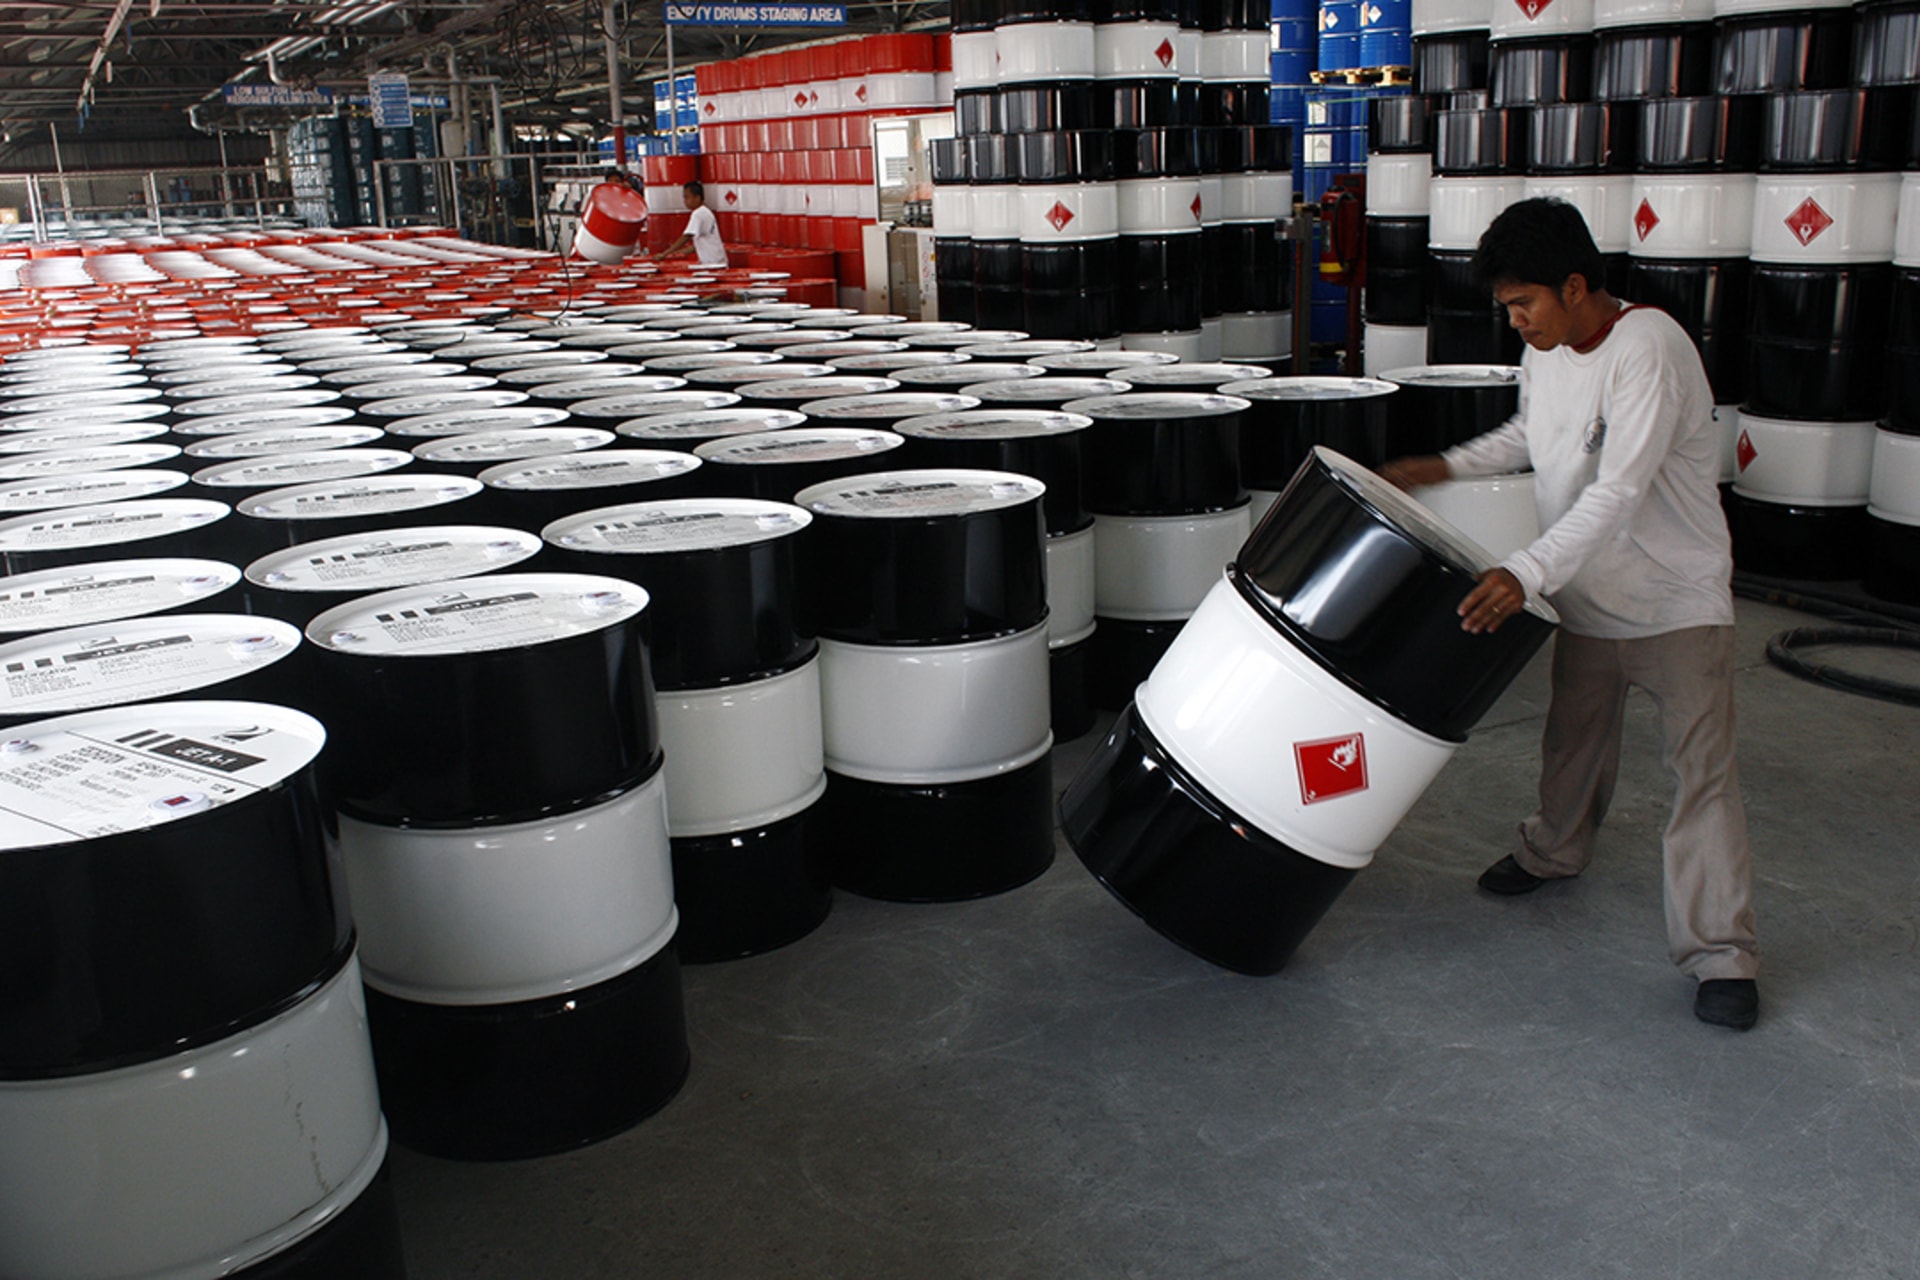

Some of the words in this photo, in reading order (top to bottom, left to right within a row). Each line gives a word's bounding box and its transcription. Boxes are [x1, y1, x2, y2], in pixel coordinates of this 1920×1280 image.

[714, 7, 757, 21] DRUMS
[759, 7, 807, 22] STAGING
[810, 8, 843, 22] AREA
[174, 746, 213, 759] JET
